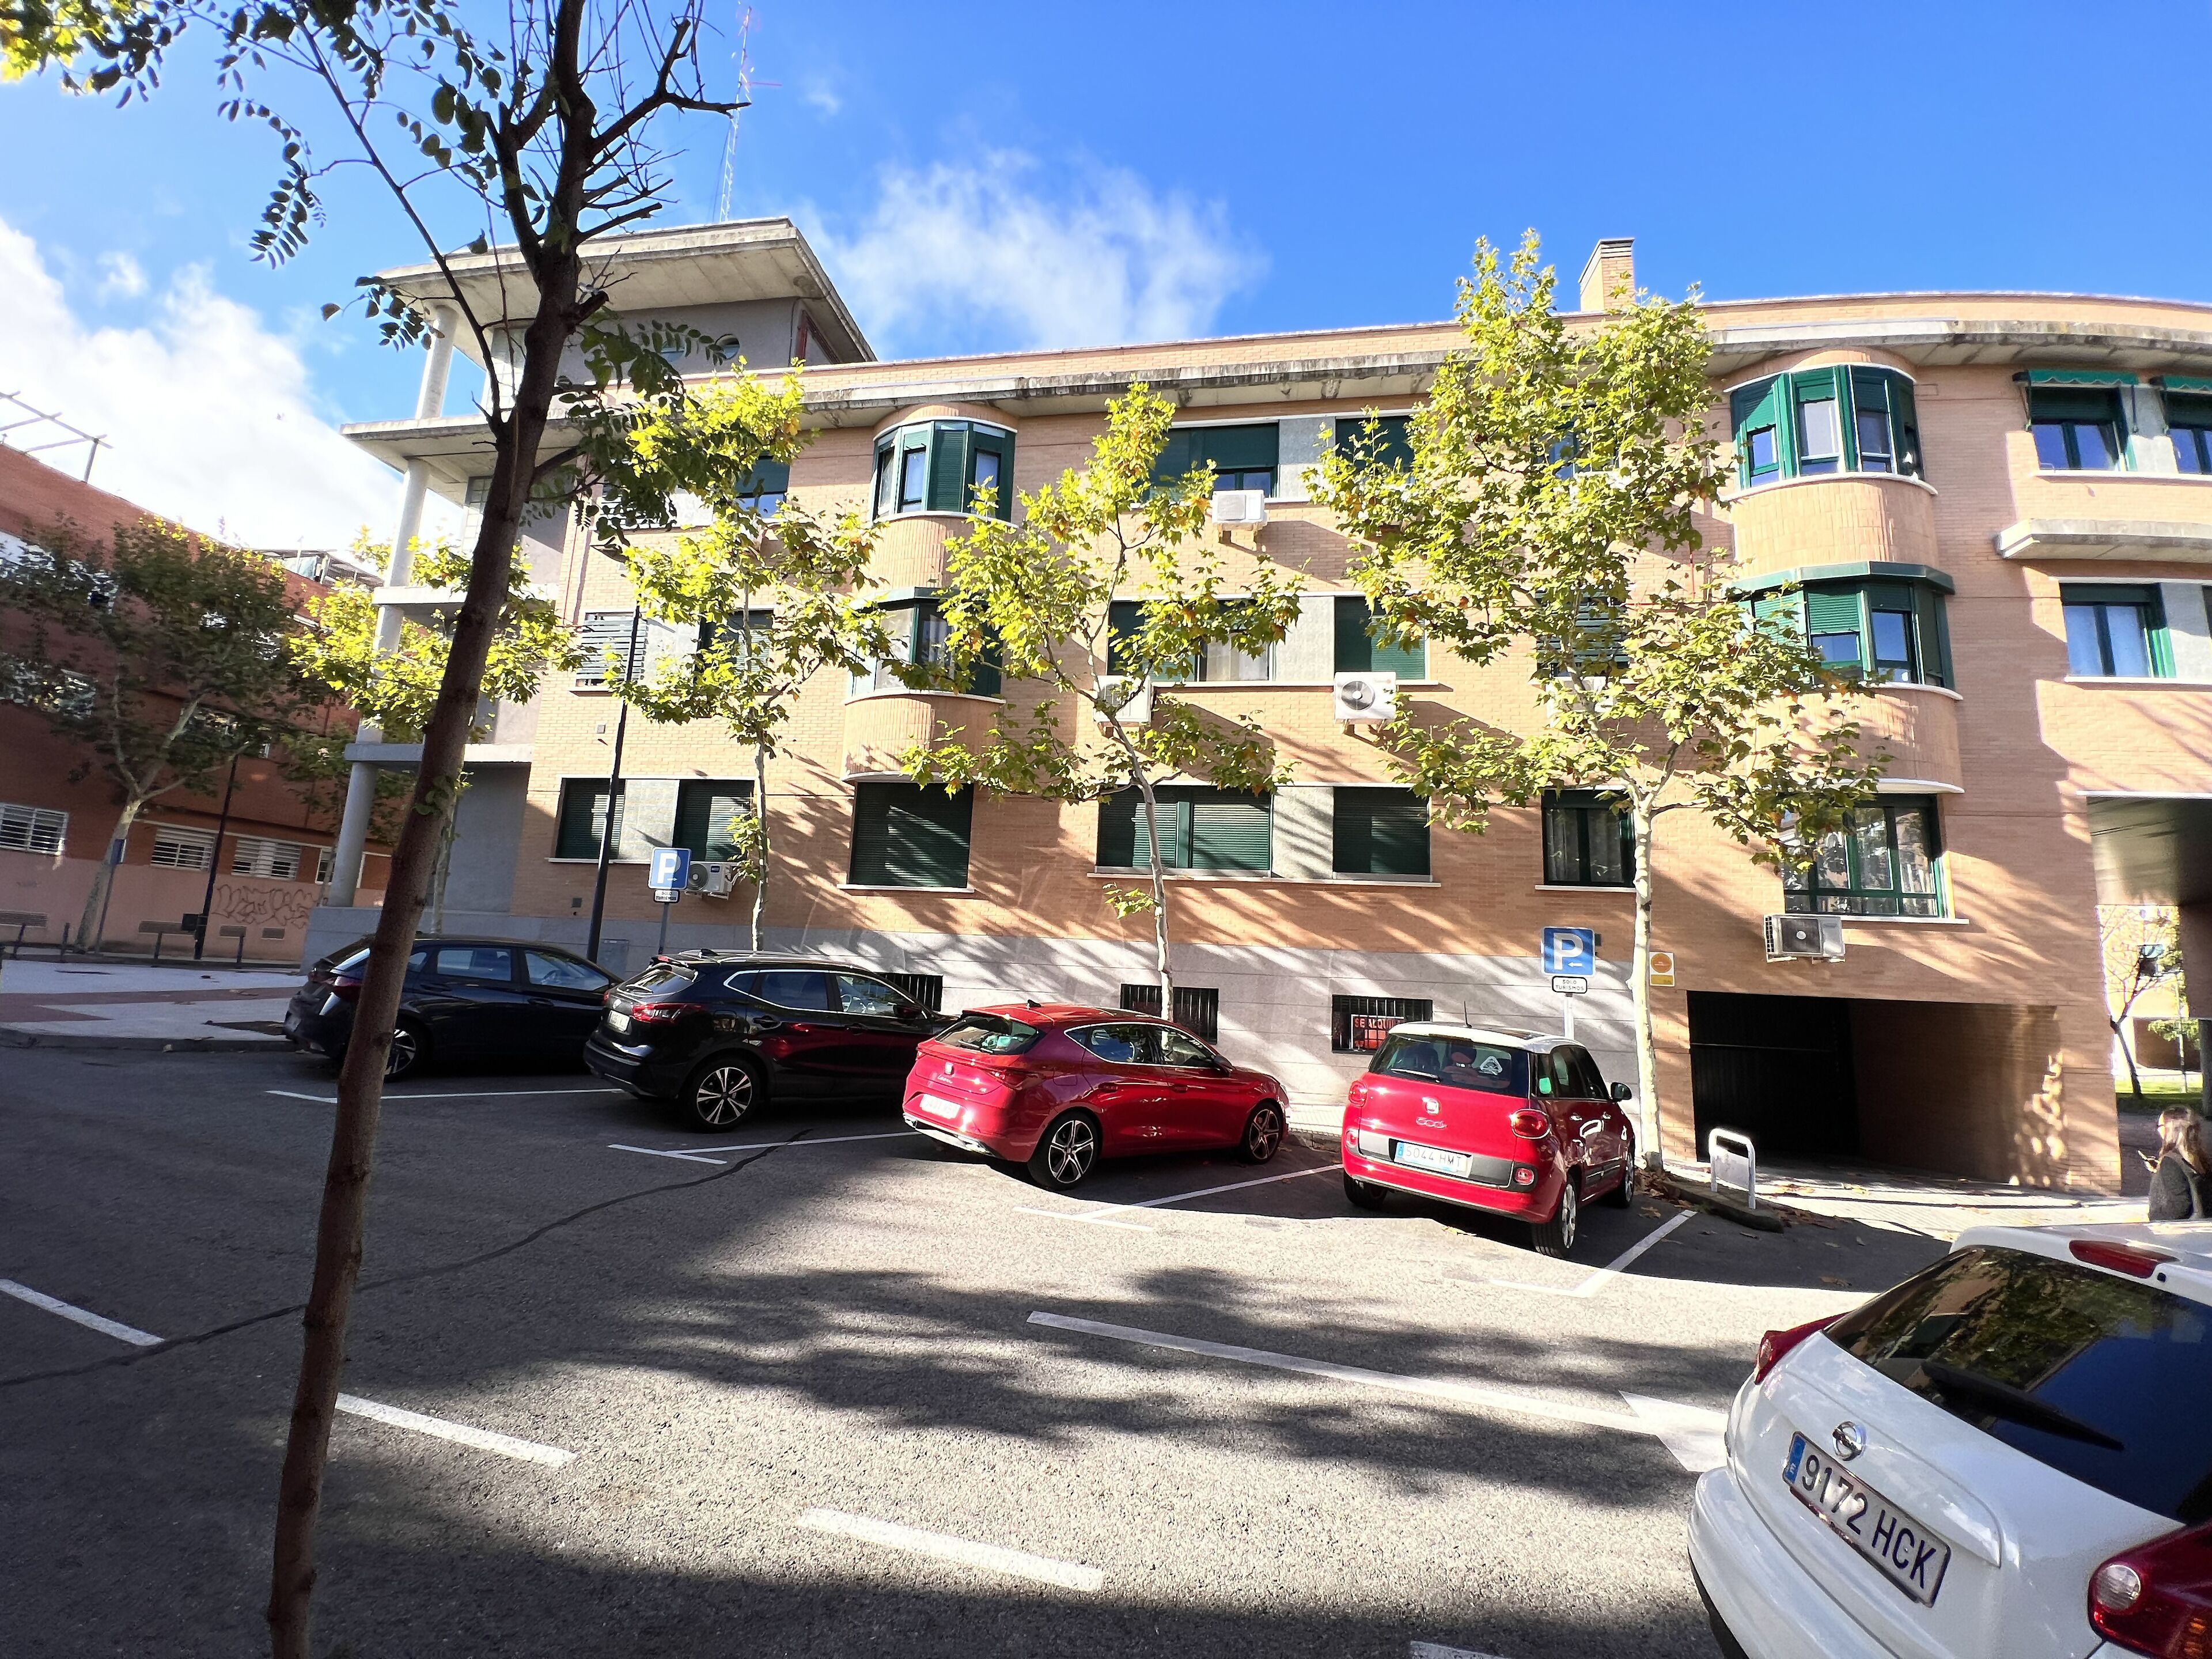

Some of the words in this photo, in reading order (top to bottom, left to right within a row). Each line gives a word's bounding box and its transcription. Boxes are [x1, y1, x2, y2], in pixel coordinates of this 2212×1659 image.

[657, 853, 681, 884] P
[1554, 933, 1584, 970] P
[1354, 1018, 1365, 1028] SE
[1406, 1146, 1434, 1161] 5044
[1440, 1153, 1461, 1167] HMT
[1802, 1455, 1868, 1535] 9172
[1872, 1509, 1936, 1589] HCK
